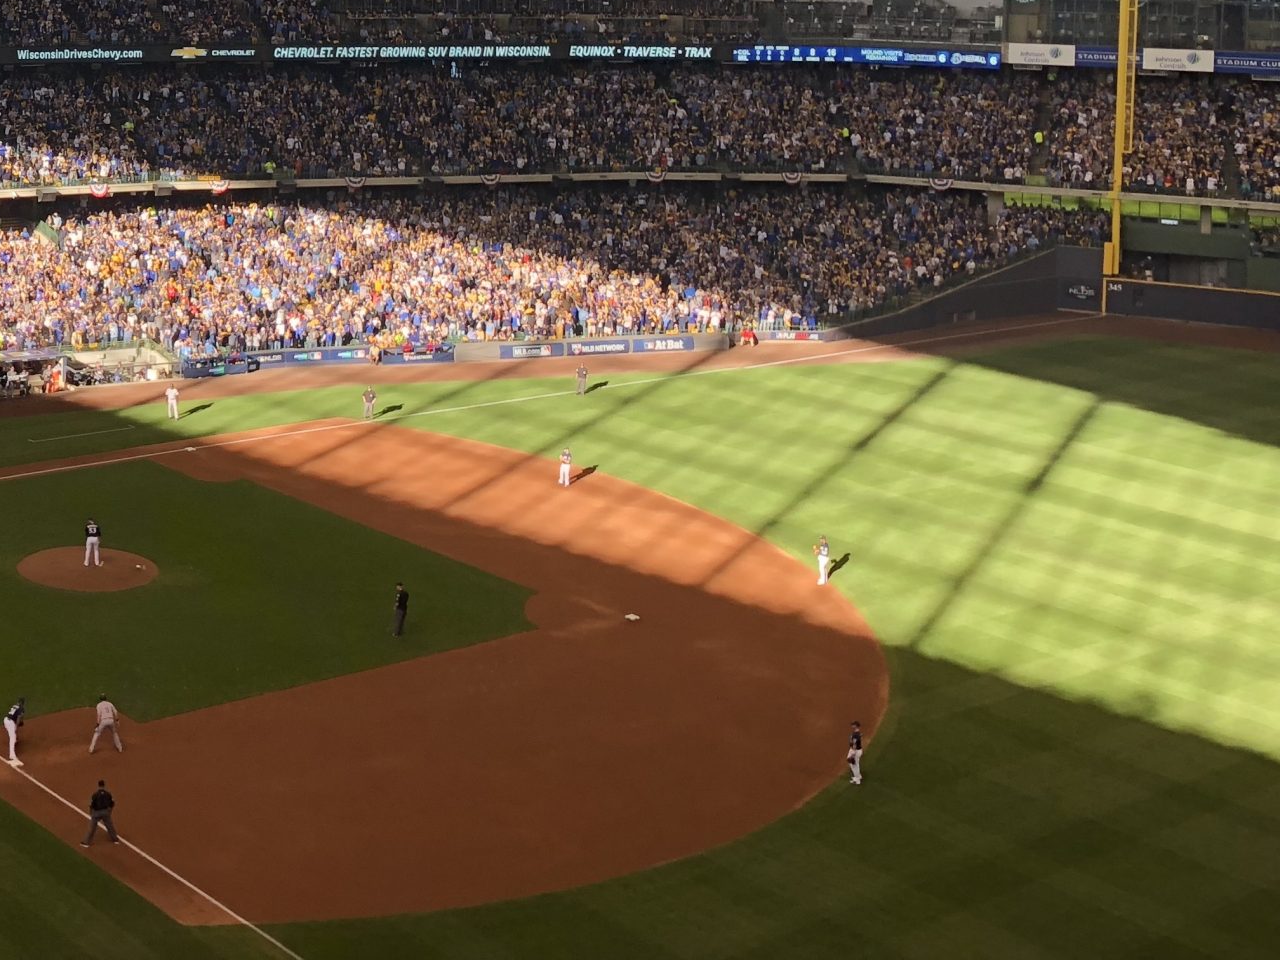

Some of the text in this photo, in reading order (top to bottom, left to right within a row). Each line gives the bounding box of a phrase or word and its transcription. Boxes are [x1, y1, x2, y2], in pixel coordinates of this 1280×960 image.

[17, 48, 143, 61] WisconsinDrivesChevy.com
[274, 45, 551, 58] CHEVROLET. FASTEST GROWING SUV BRAND IN WISCONSIN.
[570, 45, 712, 58] EQUINOX TRAVERSE TRAX
[939, 53, 946, 63] 6
[990, 56, 997, 66] 6
[1078, 53, 1117, 61] STADIUM
[1217, 59, 1258, 67] STADIUM
[1107, 283, 1123, 291] 345
[582, 343, 625, 353] MLB NETWORK
[655, 339, 684, 350] At Bat
[514, 348, 541, 356] MLB.com
